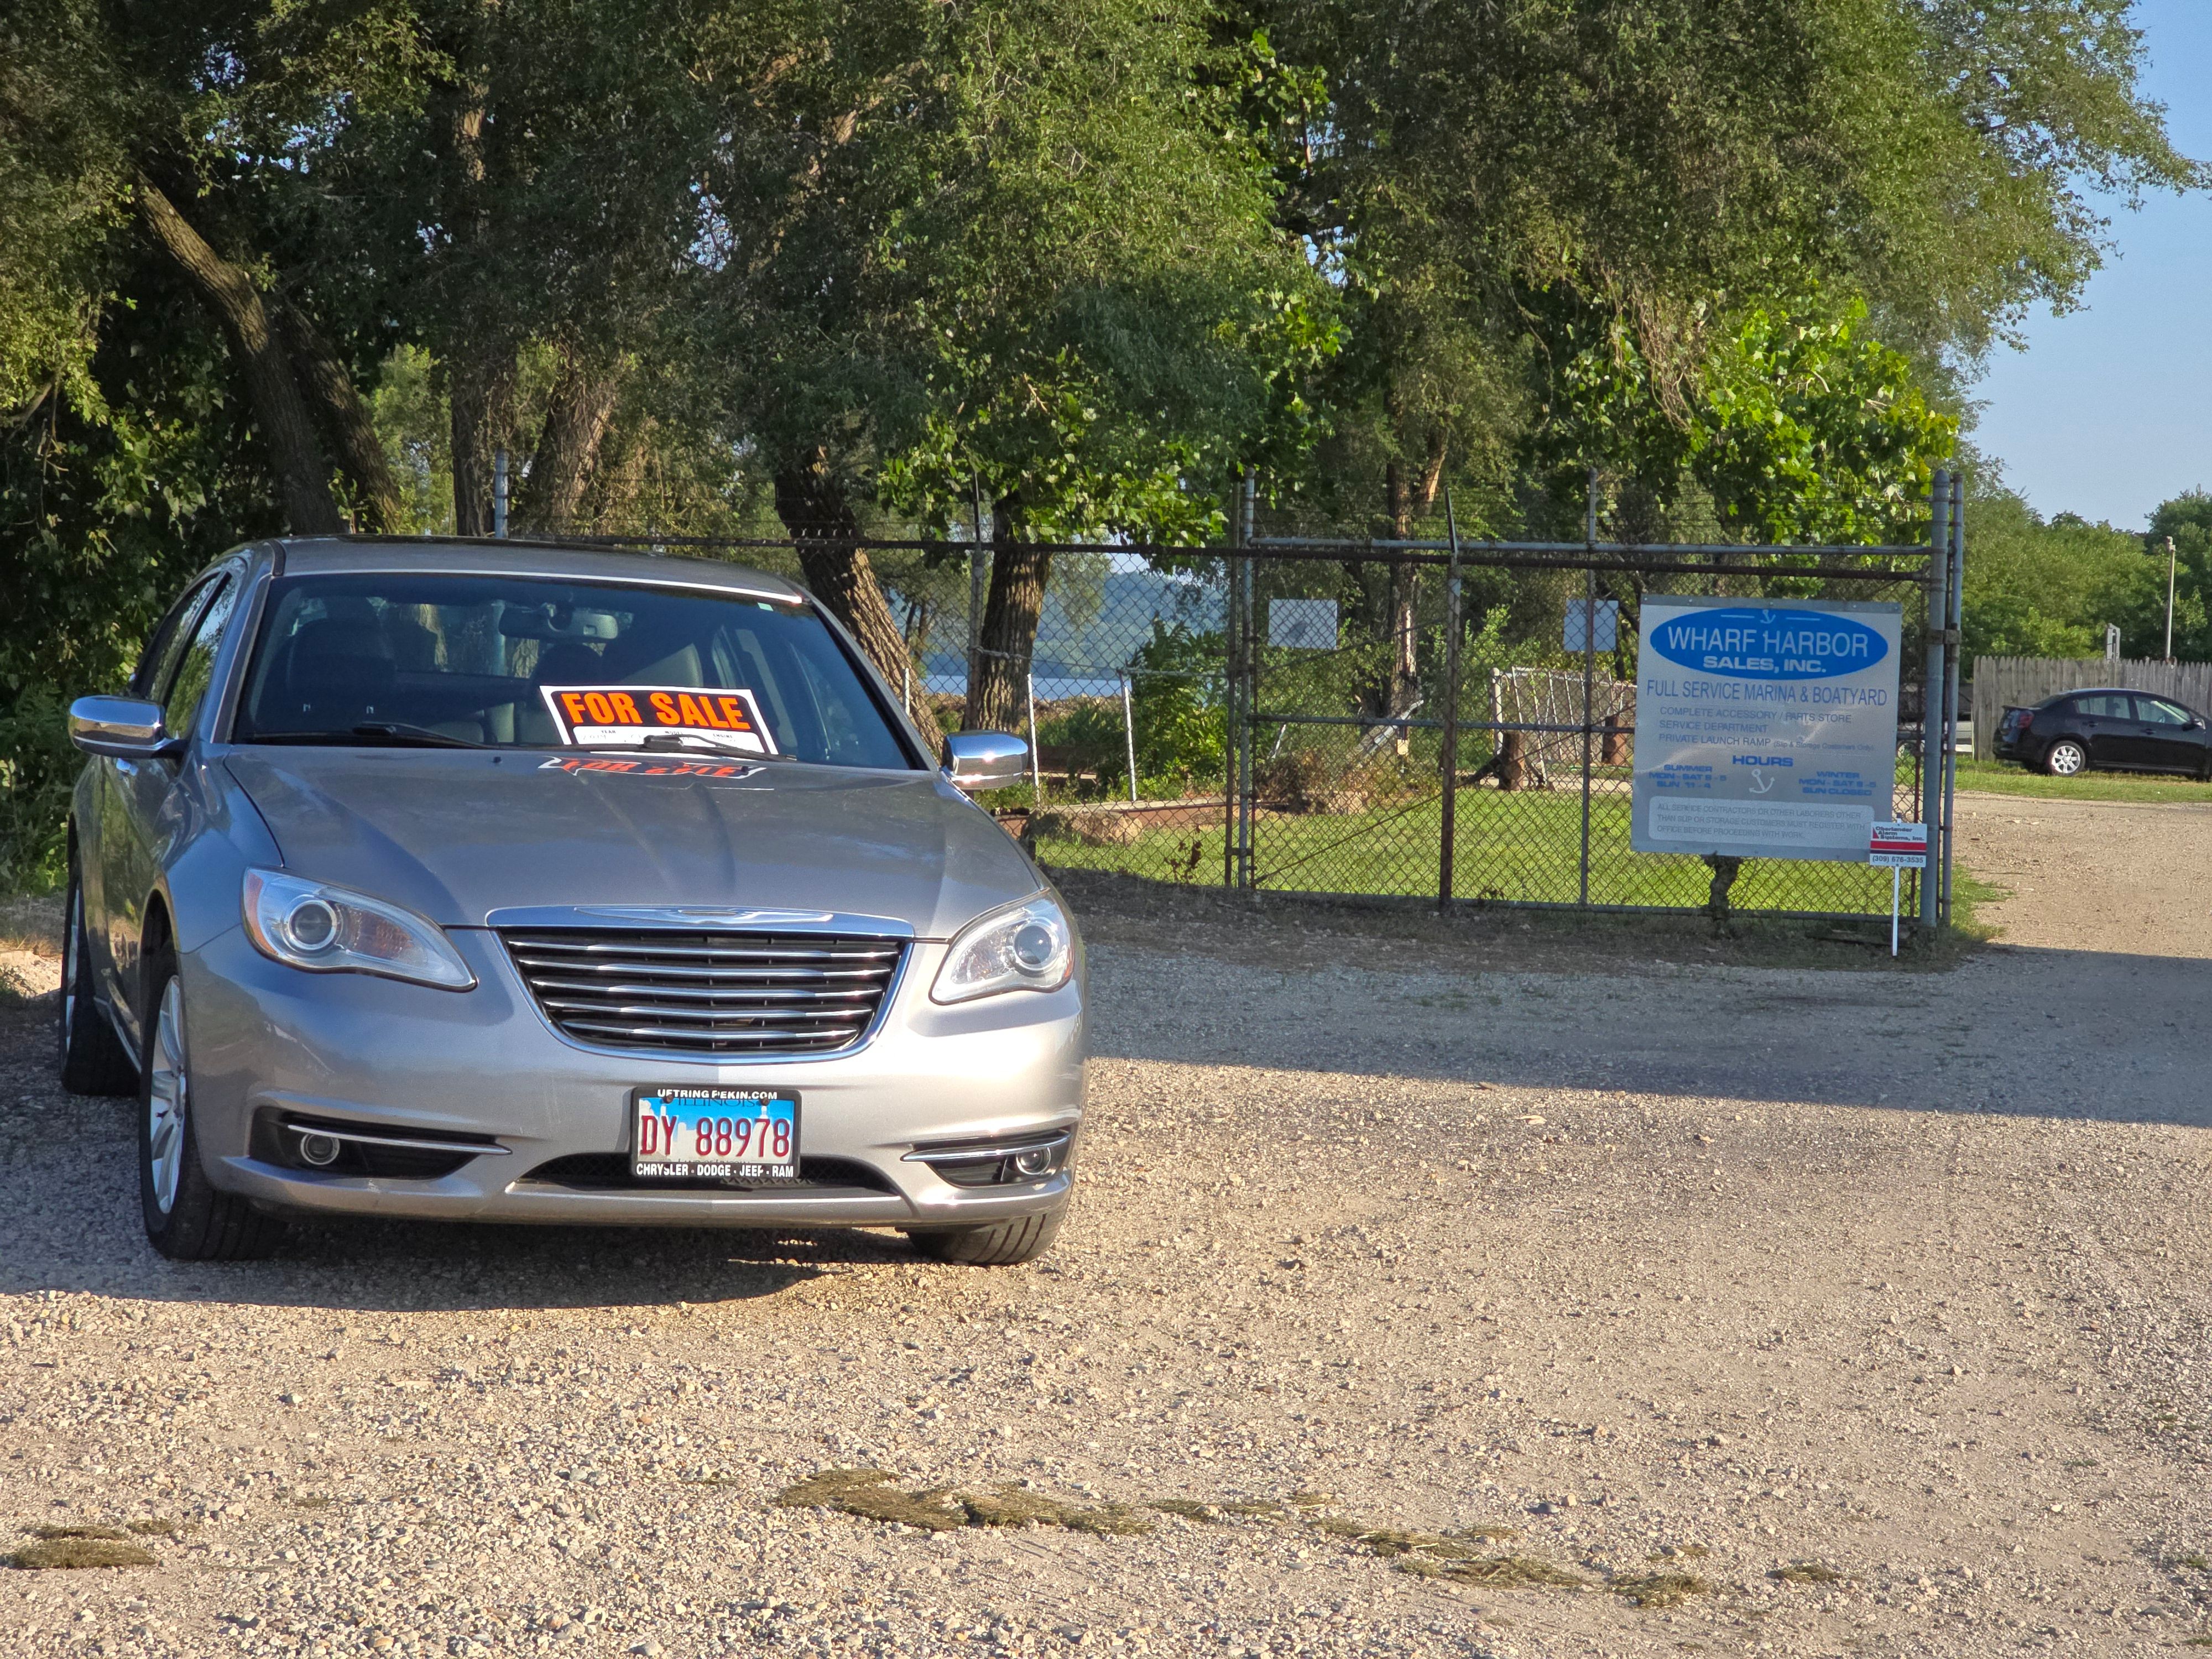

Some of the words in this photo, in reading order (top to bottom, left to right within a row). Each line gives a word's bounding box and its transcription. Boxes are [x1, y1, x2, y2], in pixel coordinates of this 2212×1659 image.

[1668, 627, 1757, 652] WHARF
[1763, 630, 1868, 657] HARBOR
[1703, 656, 1780, 674] SALES,
[1784, 659, 1827, 672] INC.
[1647, 680, 1678, 697] FULL
[1683, 681, 1740, 700] SERVICE
[1744, 684, 1796, 702] MARINA
[1800, 686, 1808, 702] &
[1813, 686, 1887, 706] BOATYARD
[561, 692, 643, 724] FOR
[649, 692, 751, 729] SALE
[1660, 707, 1713, 717] COMPLETE
[1715, 709, 1777, 719] ACCESSORY
[1786, 712, 1815, 721] PARTS
[1818, 713, 1851, 723] STORE
[1660, 720, 1701, 730] SERVICE
[1704, 722, 1768, 733] DEPARTMENT
[1659, 733, 1698, 743] PRIVATE
[1701, 735, 1740, 745] LAUNCH
[1743, 737, 1771, 747] RAMP
[1732, 755, 1793, 767] HOURS
[1703, 805, 1756, 814] CONTRACTORS
[1797, 810, 1834, 818] LABORERS
[1705, 817, 1739, 825] STORAGE
[1741, 818, 1786, 827] CUSTOMERS
[1715, 828, 1760, 837] PROCEEDING
[640, 1115, 677, 1155] DY
[696, 1117, 790, 1157] 88978
[637, 1163, 688, 1176] CHRYSLER
[697, 1164, 731, 1176] DODGE
[739, 1165, 764, 1177] JEEP
[772, 1165, 794, 1177] RAM
